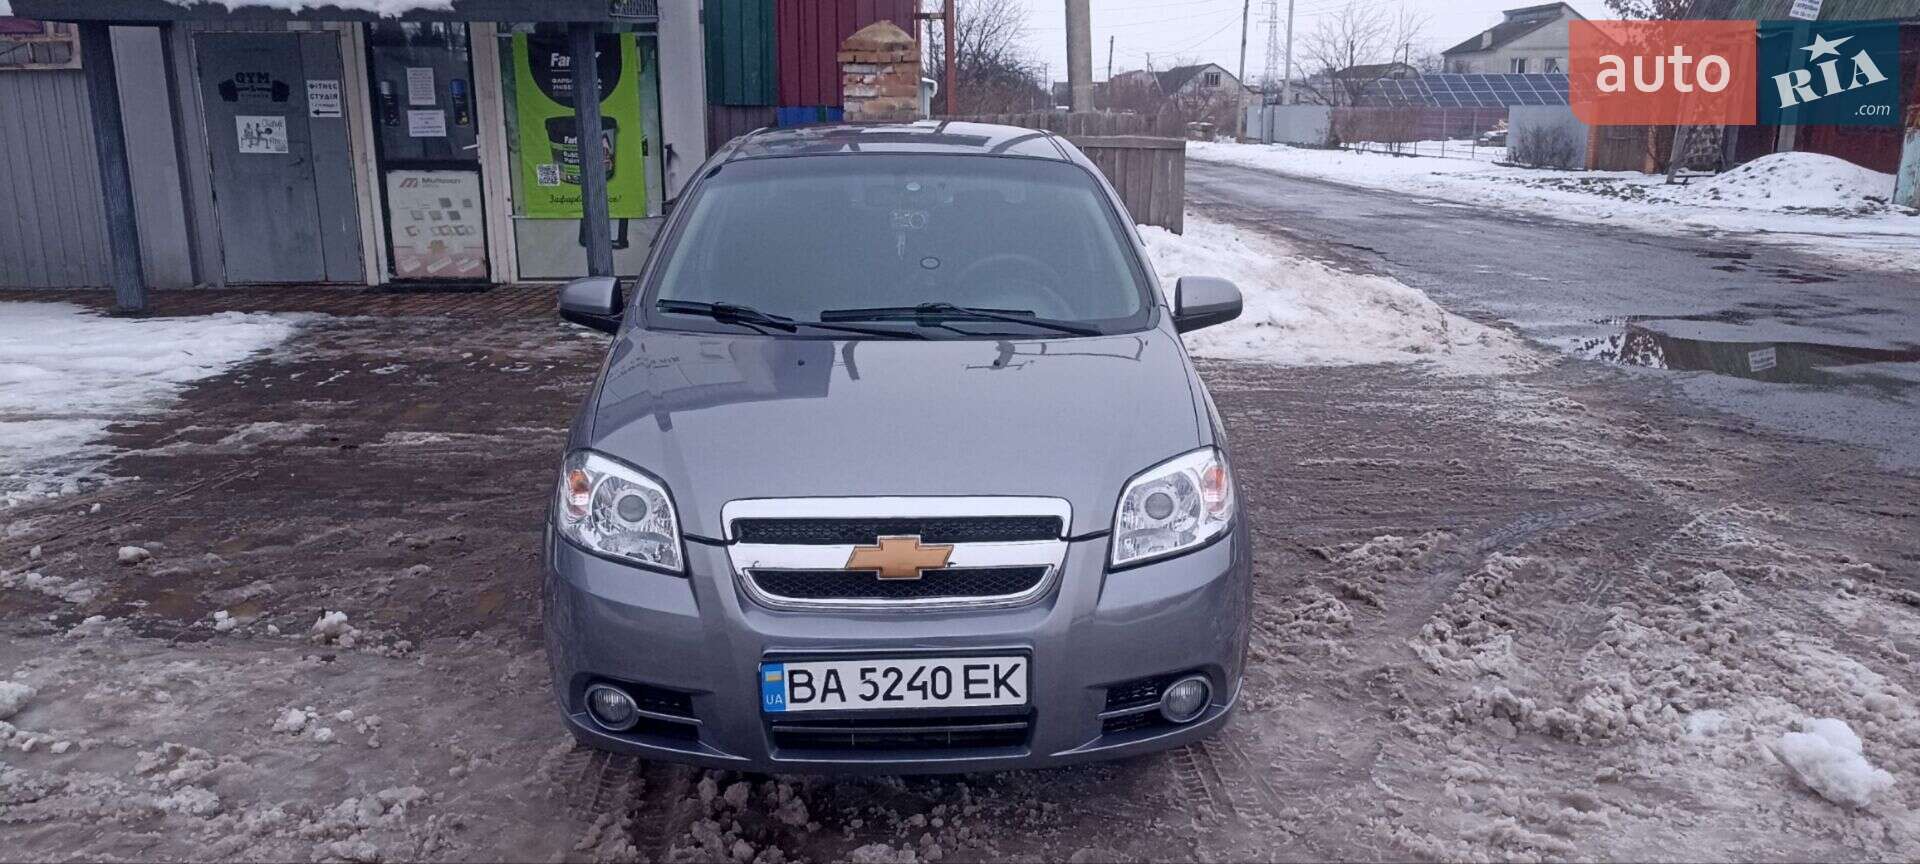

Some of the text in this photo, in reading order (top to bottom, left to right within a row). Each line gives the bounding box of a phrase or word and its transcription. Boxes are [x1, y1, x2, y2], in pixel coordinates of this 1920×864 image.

[235, 72, 270, 83] GYM
[766, 663, 1022, 705] UA BA 5240 EK
